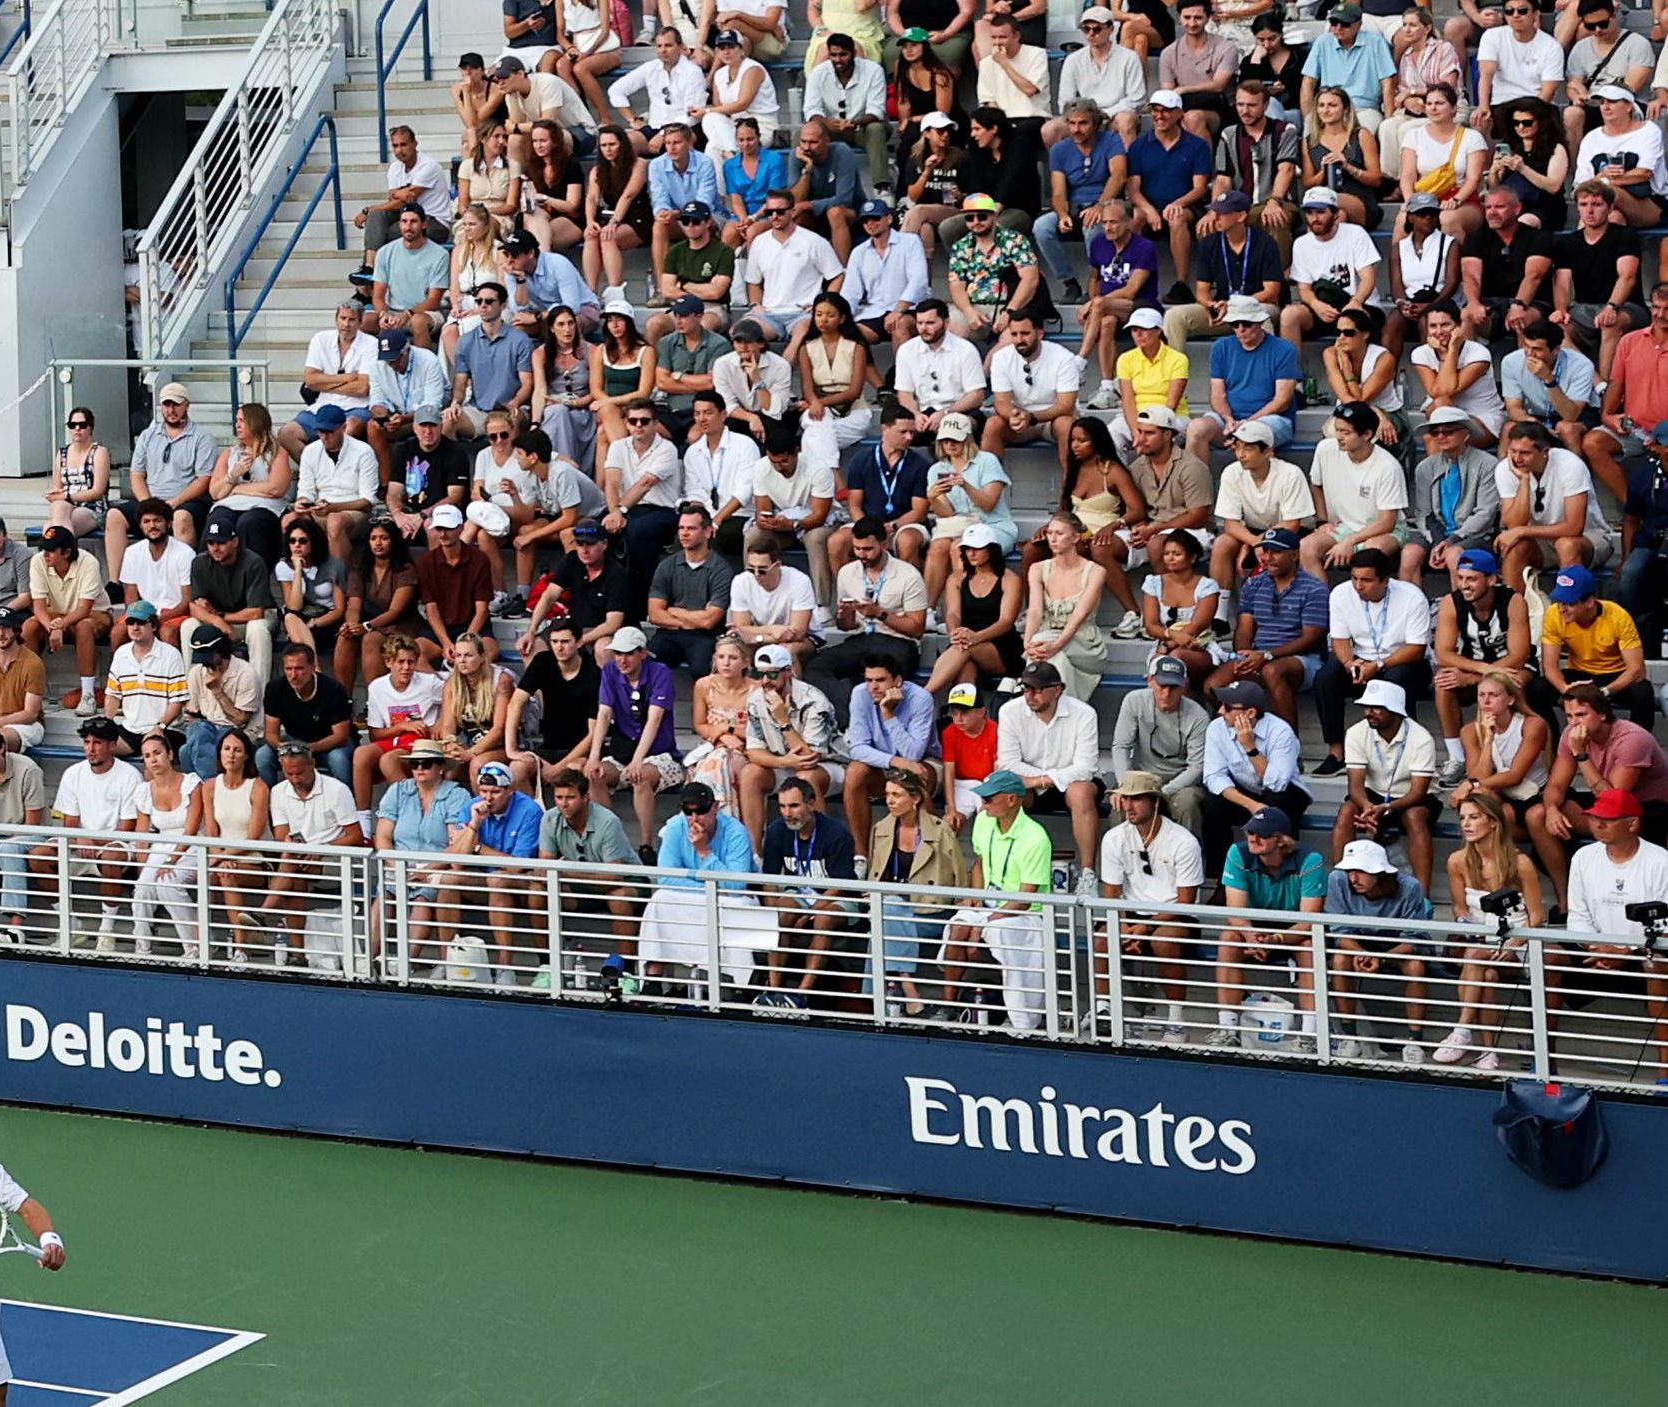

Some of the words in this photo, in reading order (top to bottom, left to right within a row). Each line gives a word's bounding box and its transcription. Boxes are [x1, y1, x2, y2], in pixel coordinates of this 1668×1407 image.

[943, 421, 961, 431] PHL
[5, 1003, 282, 1088] Deloitte.
[903, 1076, 1257, 1175] Emirates
